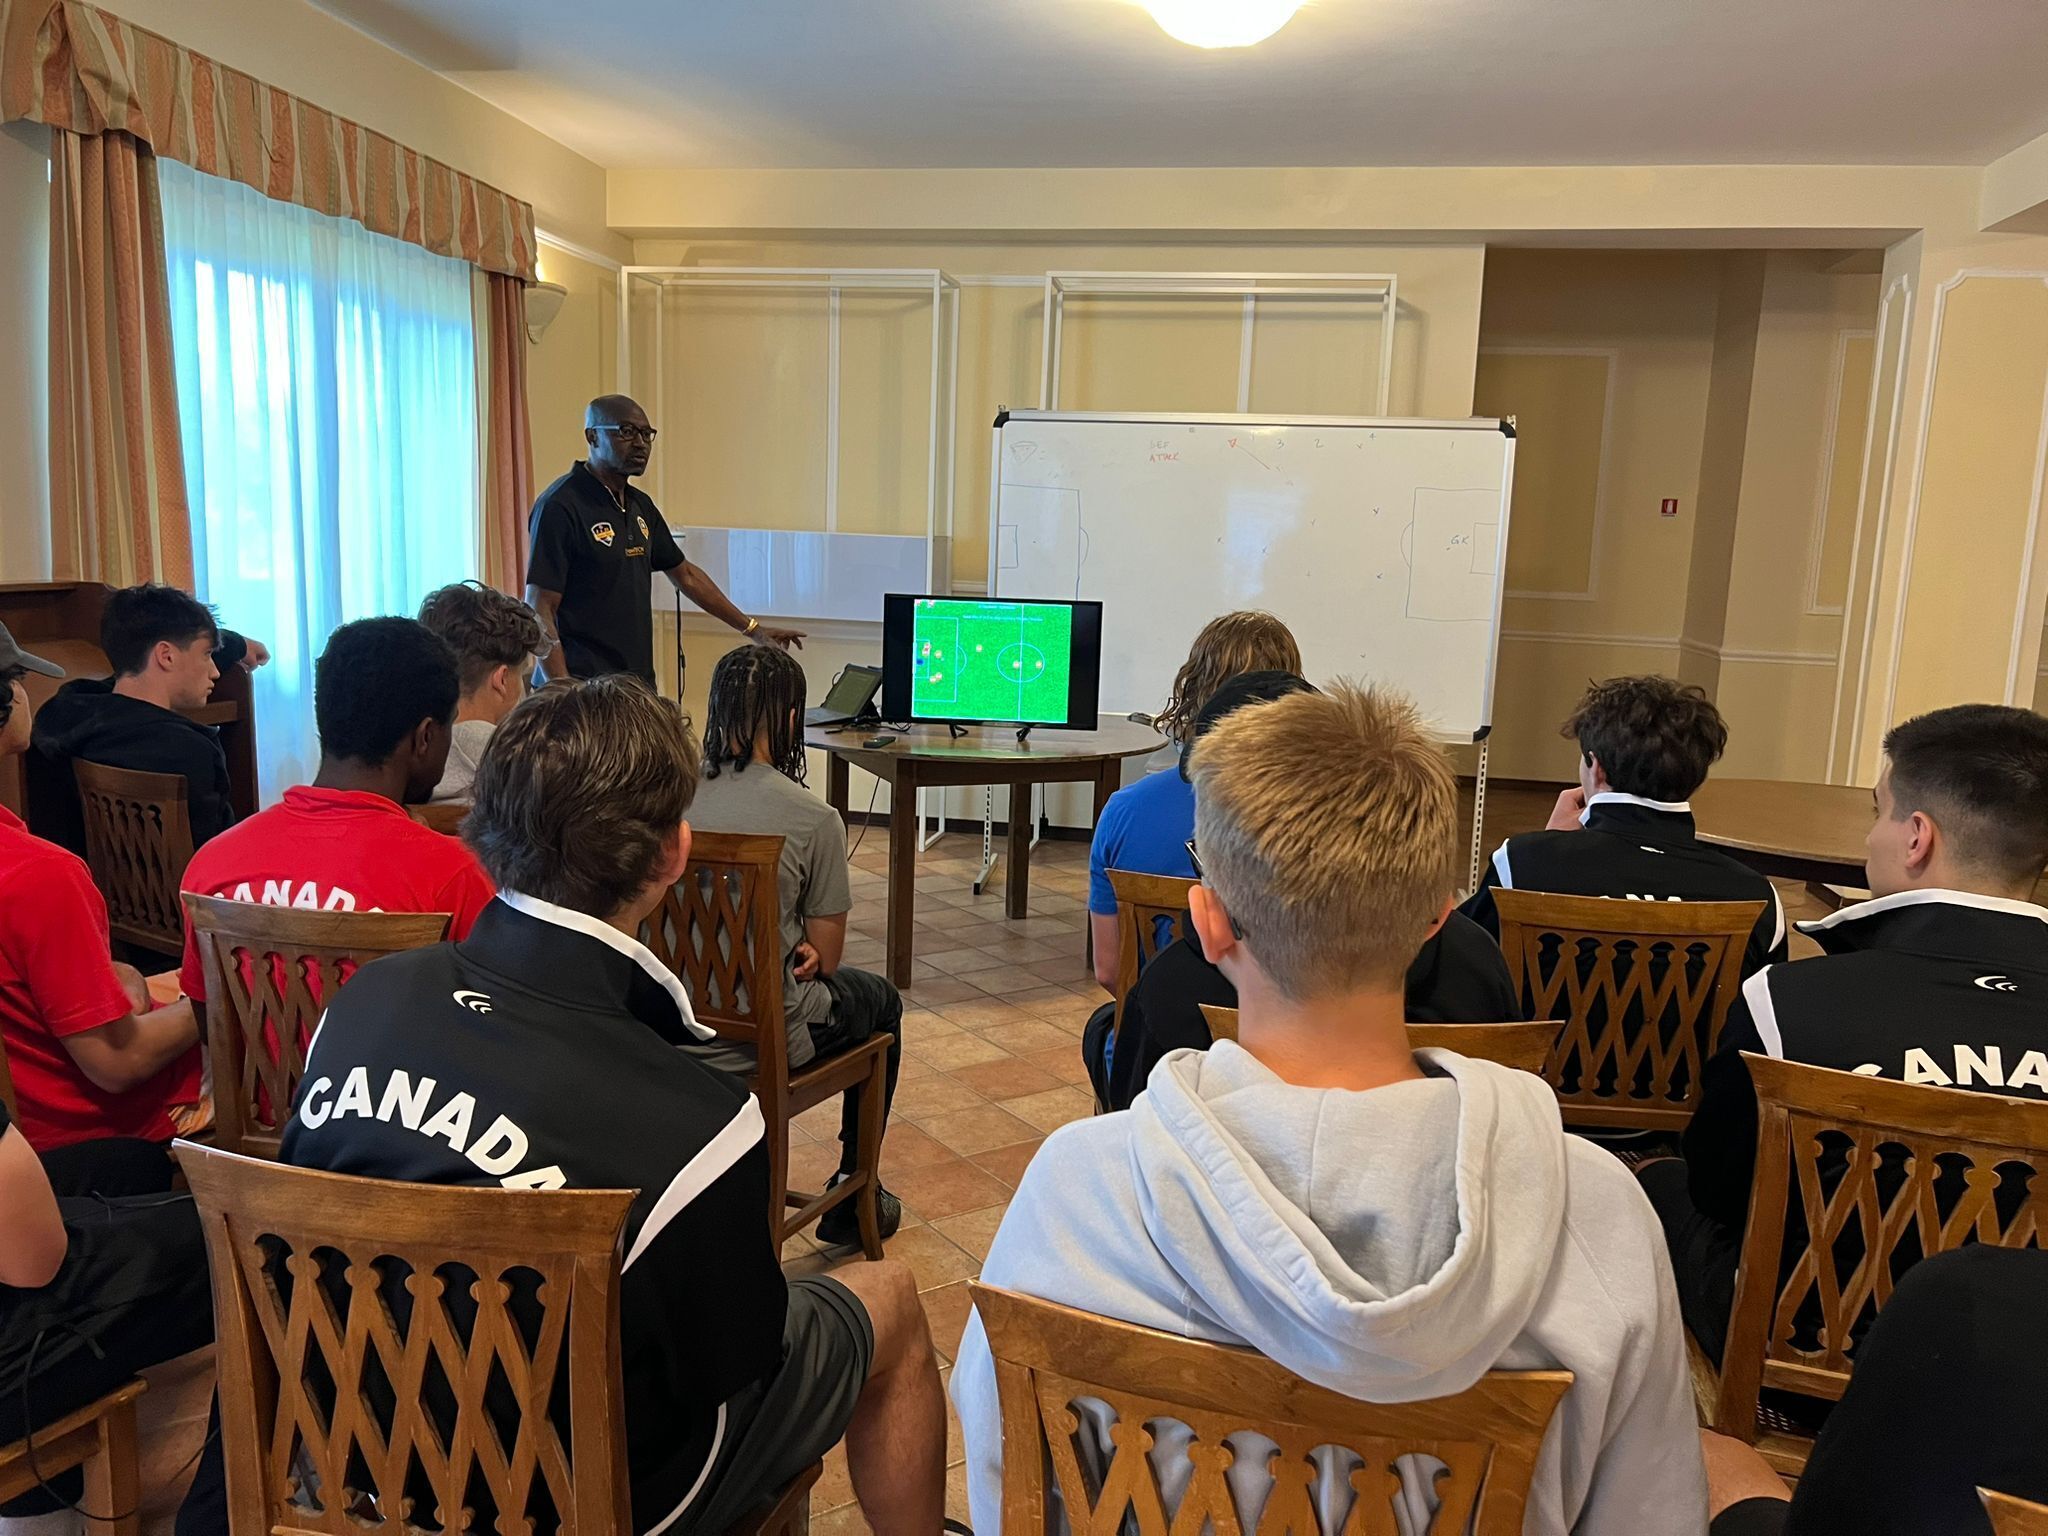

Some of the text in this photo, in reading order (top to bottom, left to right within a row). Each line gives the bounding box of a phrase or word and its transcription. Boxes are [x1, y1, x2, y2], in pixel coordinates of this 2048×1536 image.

[1314, 438, 1325, 449] 2
[1450, 534, 1470, 545] GK
[213, 880, 385, 913] ANAD
[1850, 1044, 2048, 1094] ANA
